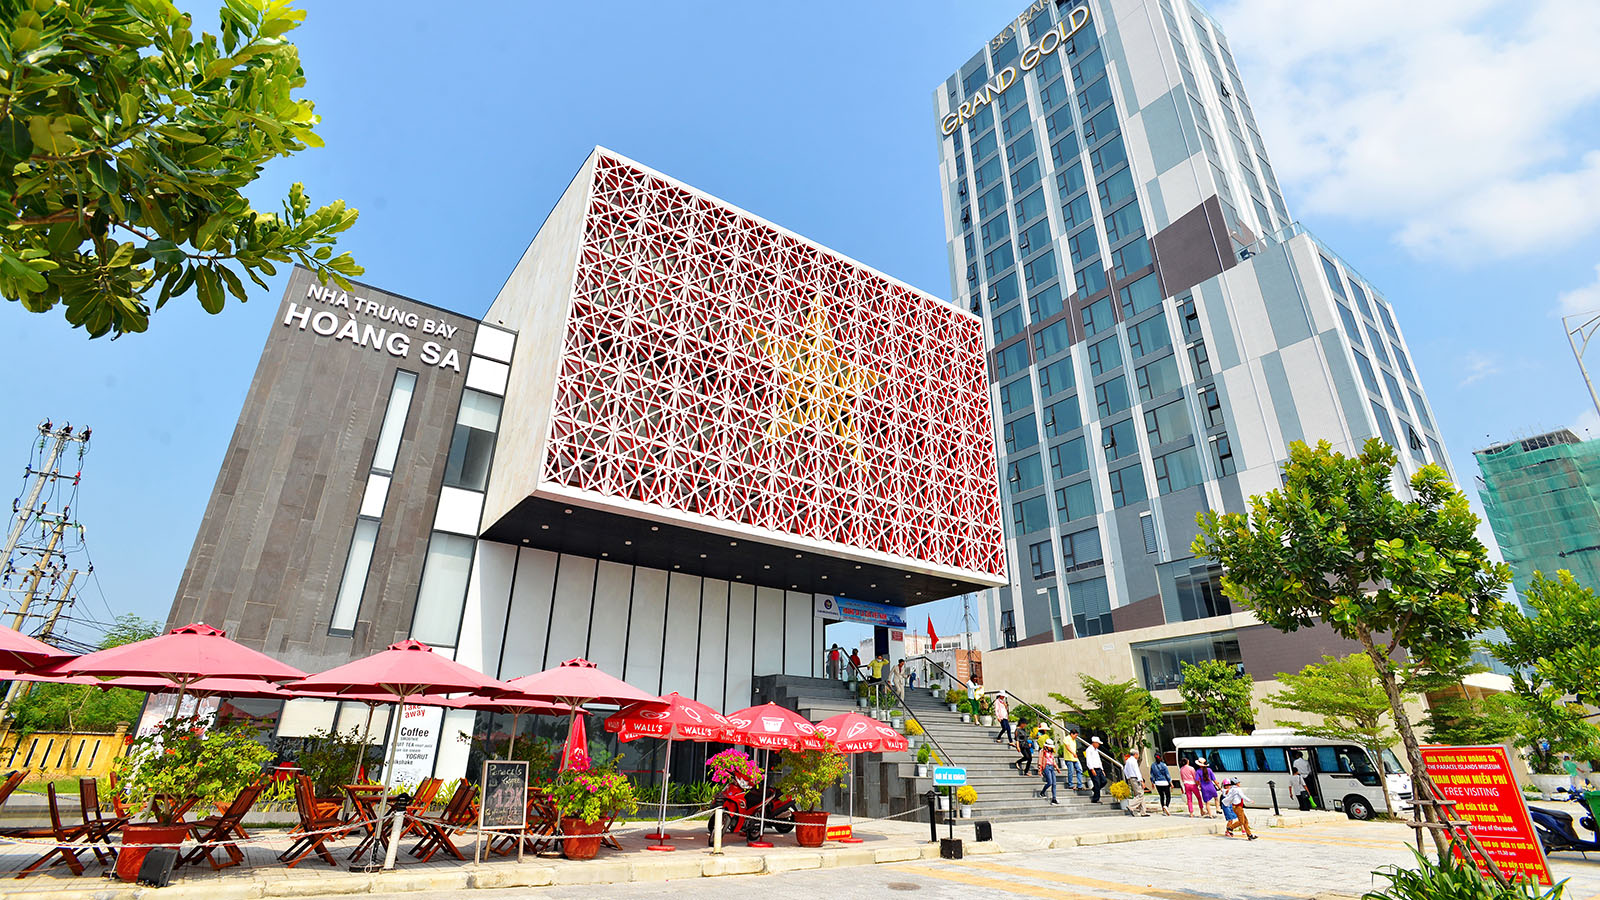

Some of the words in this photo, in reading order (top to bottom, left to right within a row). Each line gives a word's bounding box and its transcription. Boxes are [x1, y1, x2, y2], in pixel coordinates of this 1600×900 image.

[941, 66, 1016, 136] GRAND
[1020, 5, 1090, 72] GOLD
[307, 283, 350, 310] NHÀ
[354, 296, 420, 329] TRƯNG
[423, 319, 458, 340] BÀY
[283, 302, 411, 358] HOÀNG
[420, 341, 461, 373] SA
[405, 709, 425, 718] away
[401, 727, 429, 737] Coffee
[633, 723, 663, 733] WALL'S
[683, 726, 712, 736] WALL'S
[759, 737, 788, 746] WALL'S
[804, 739, 821, 748] WALL'S
[846, 742, 873, 750] WALL'S
[887, 741, 903, 749] WALL'S
[1430, 774, 1451, 784] THAM
[1451, 775, 1472, 785] QUAN
[1492, 774, 1508, 785] PHÍ
[1444, 787, 1464, 796] FREE
[1464, 787, 1500, 797] VISITING
